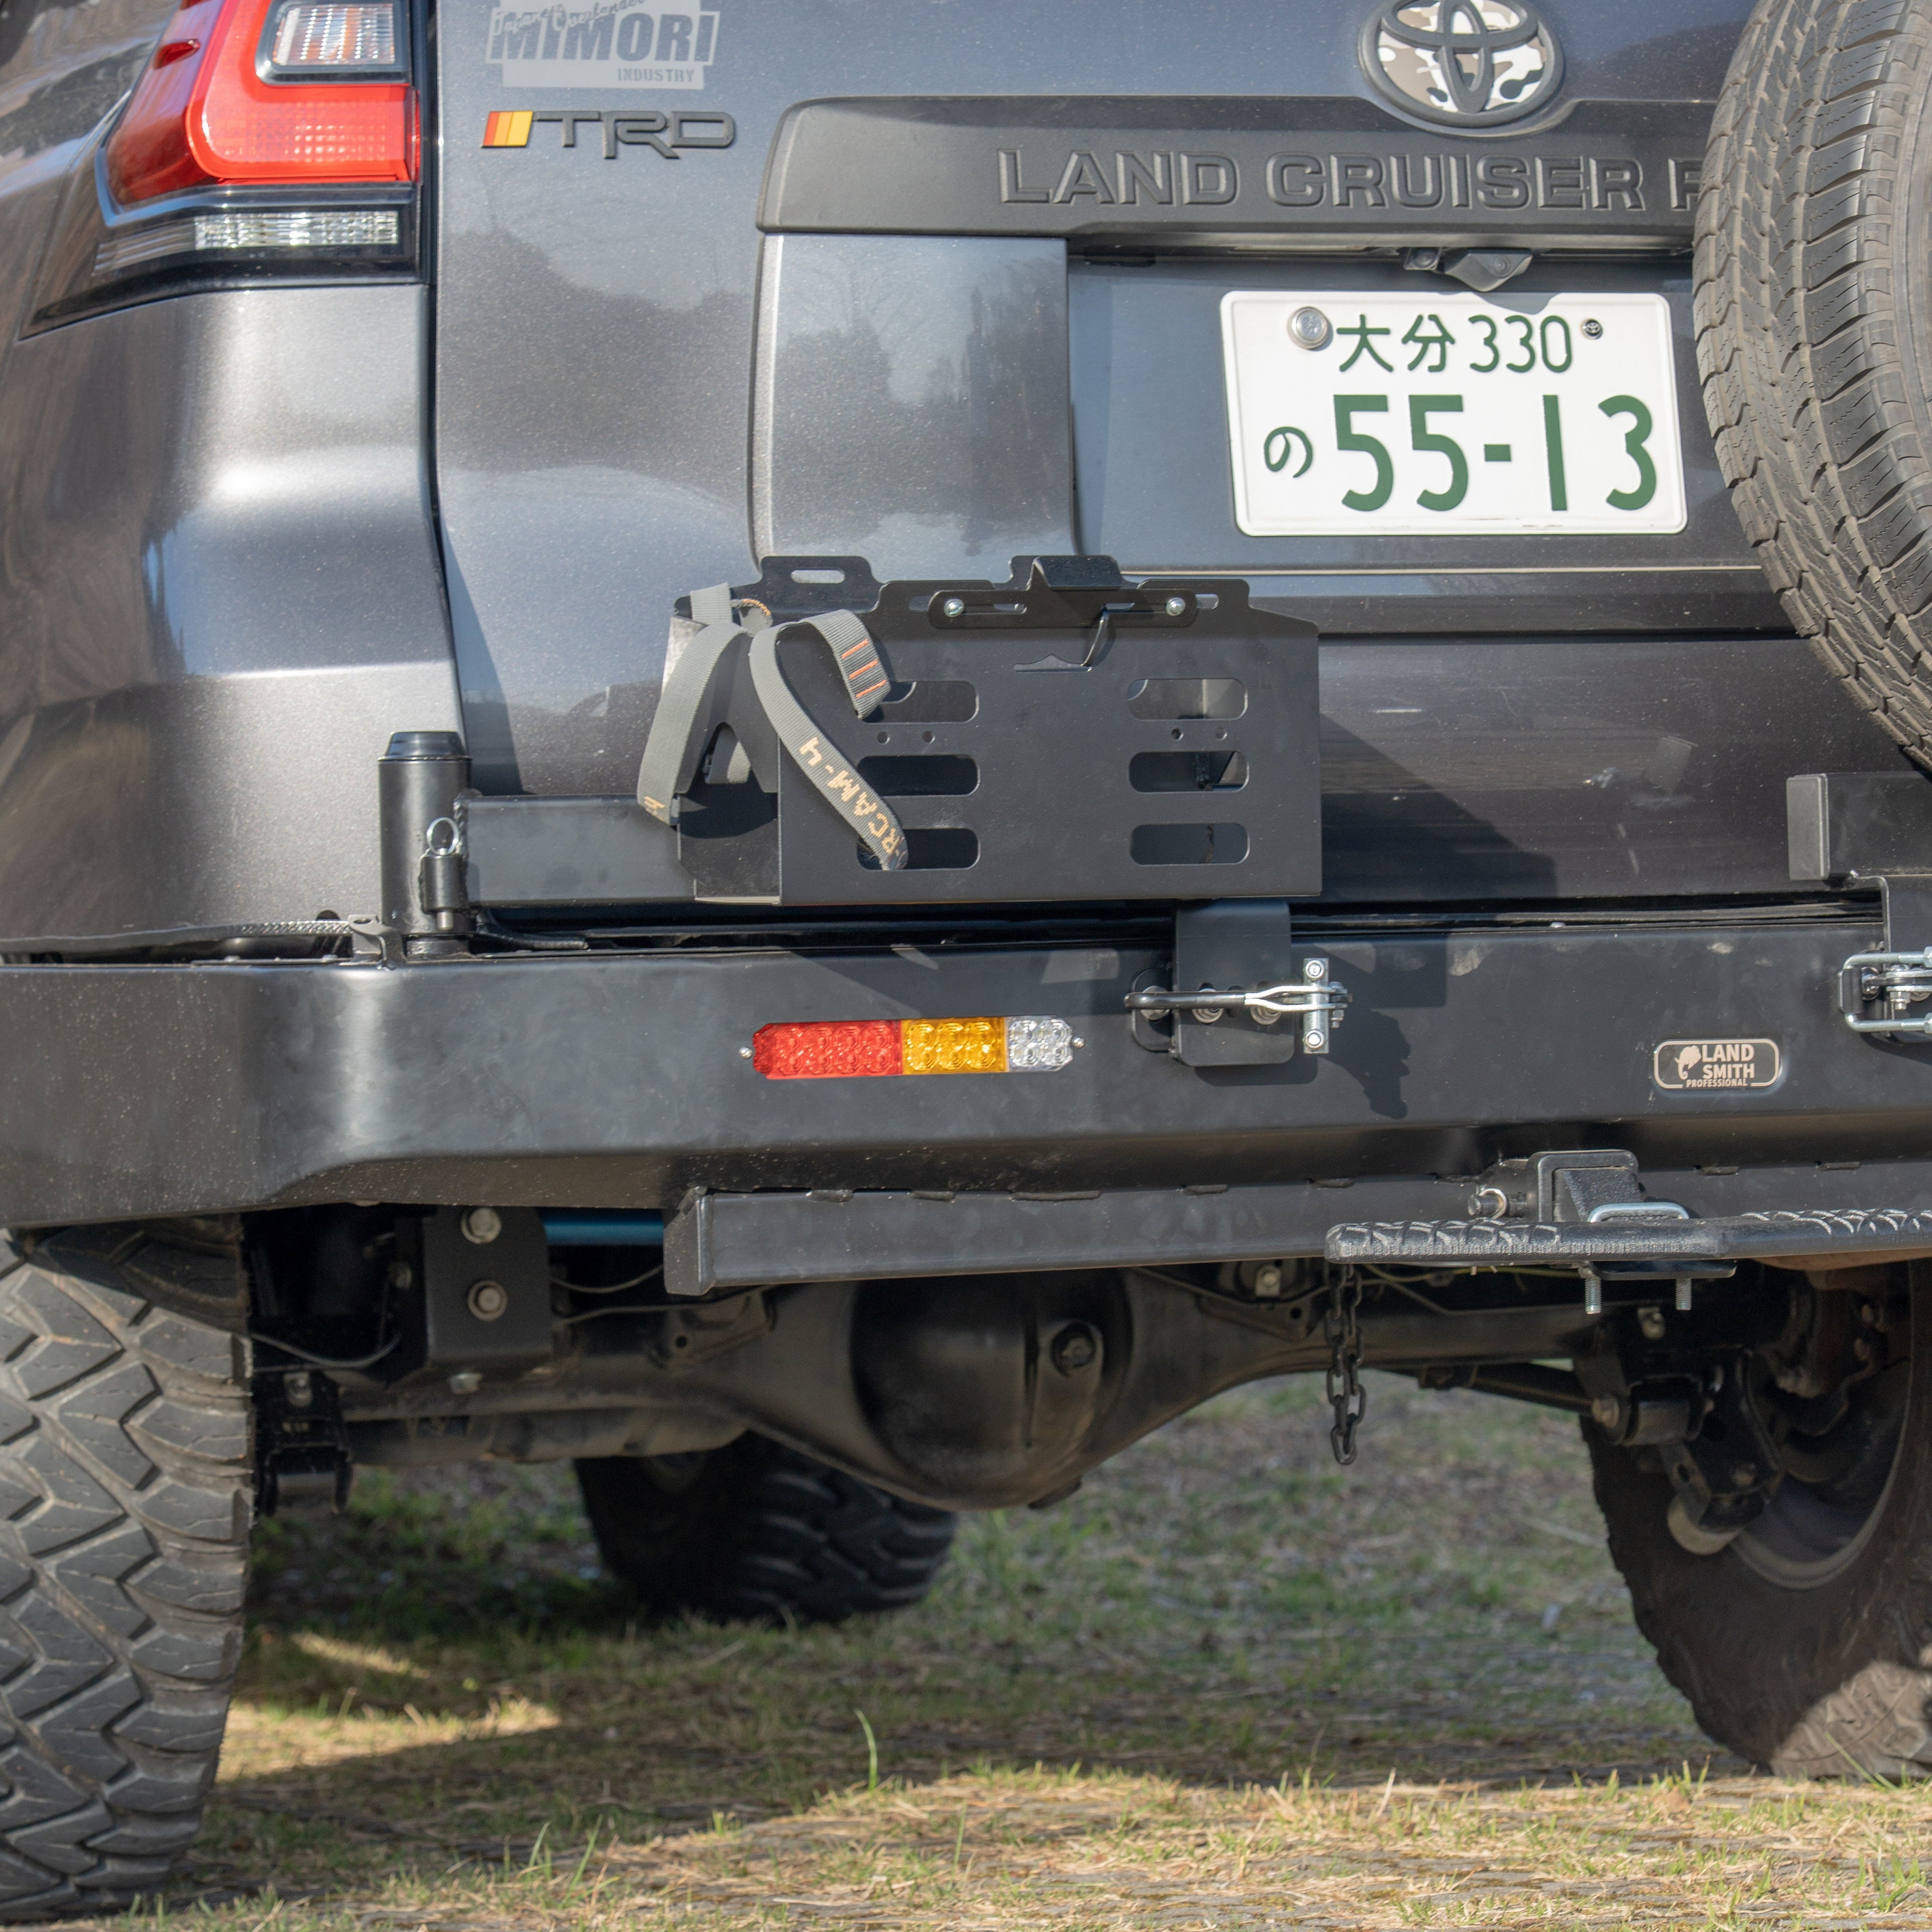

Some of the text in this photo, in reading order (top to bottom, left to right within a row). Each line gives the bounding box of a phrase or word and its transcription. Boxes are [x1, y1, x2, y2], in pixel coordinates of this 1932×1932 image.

[490, 12, 714, 62] MIMORI
[618, 68, 695, 83] INDUSTRY
[532, 111, 738, 159] TRD
[998, 149, 1240, 208] LAND
[1265, 151, 1646, 211] CRUISER
[1264, 394, 1656, 511] の 55-13
[1702, 1044, 1755, 1063] LAND
[1686, 1078, 1748, 1088] PROFESSIONAL
[1702, 1063, 1755, 1080] SMITH
